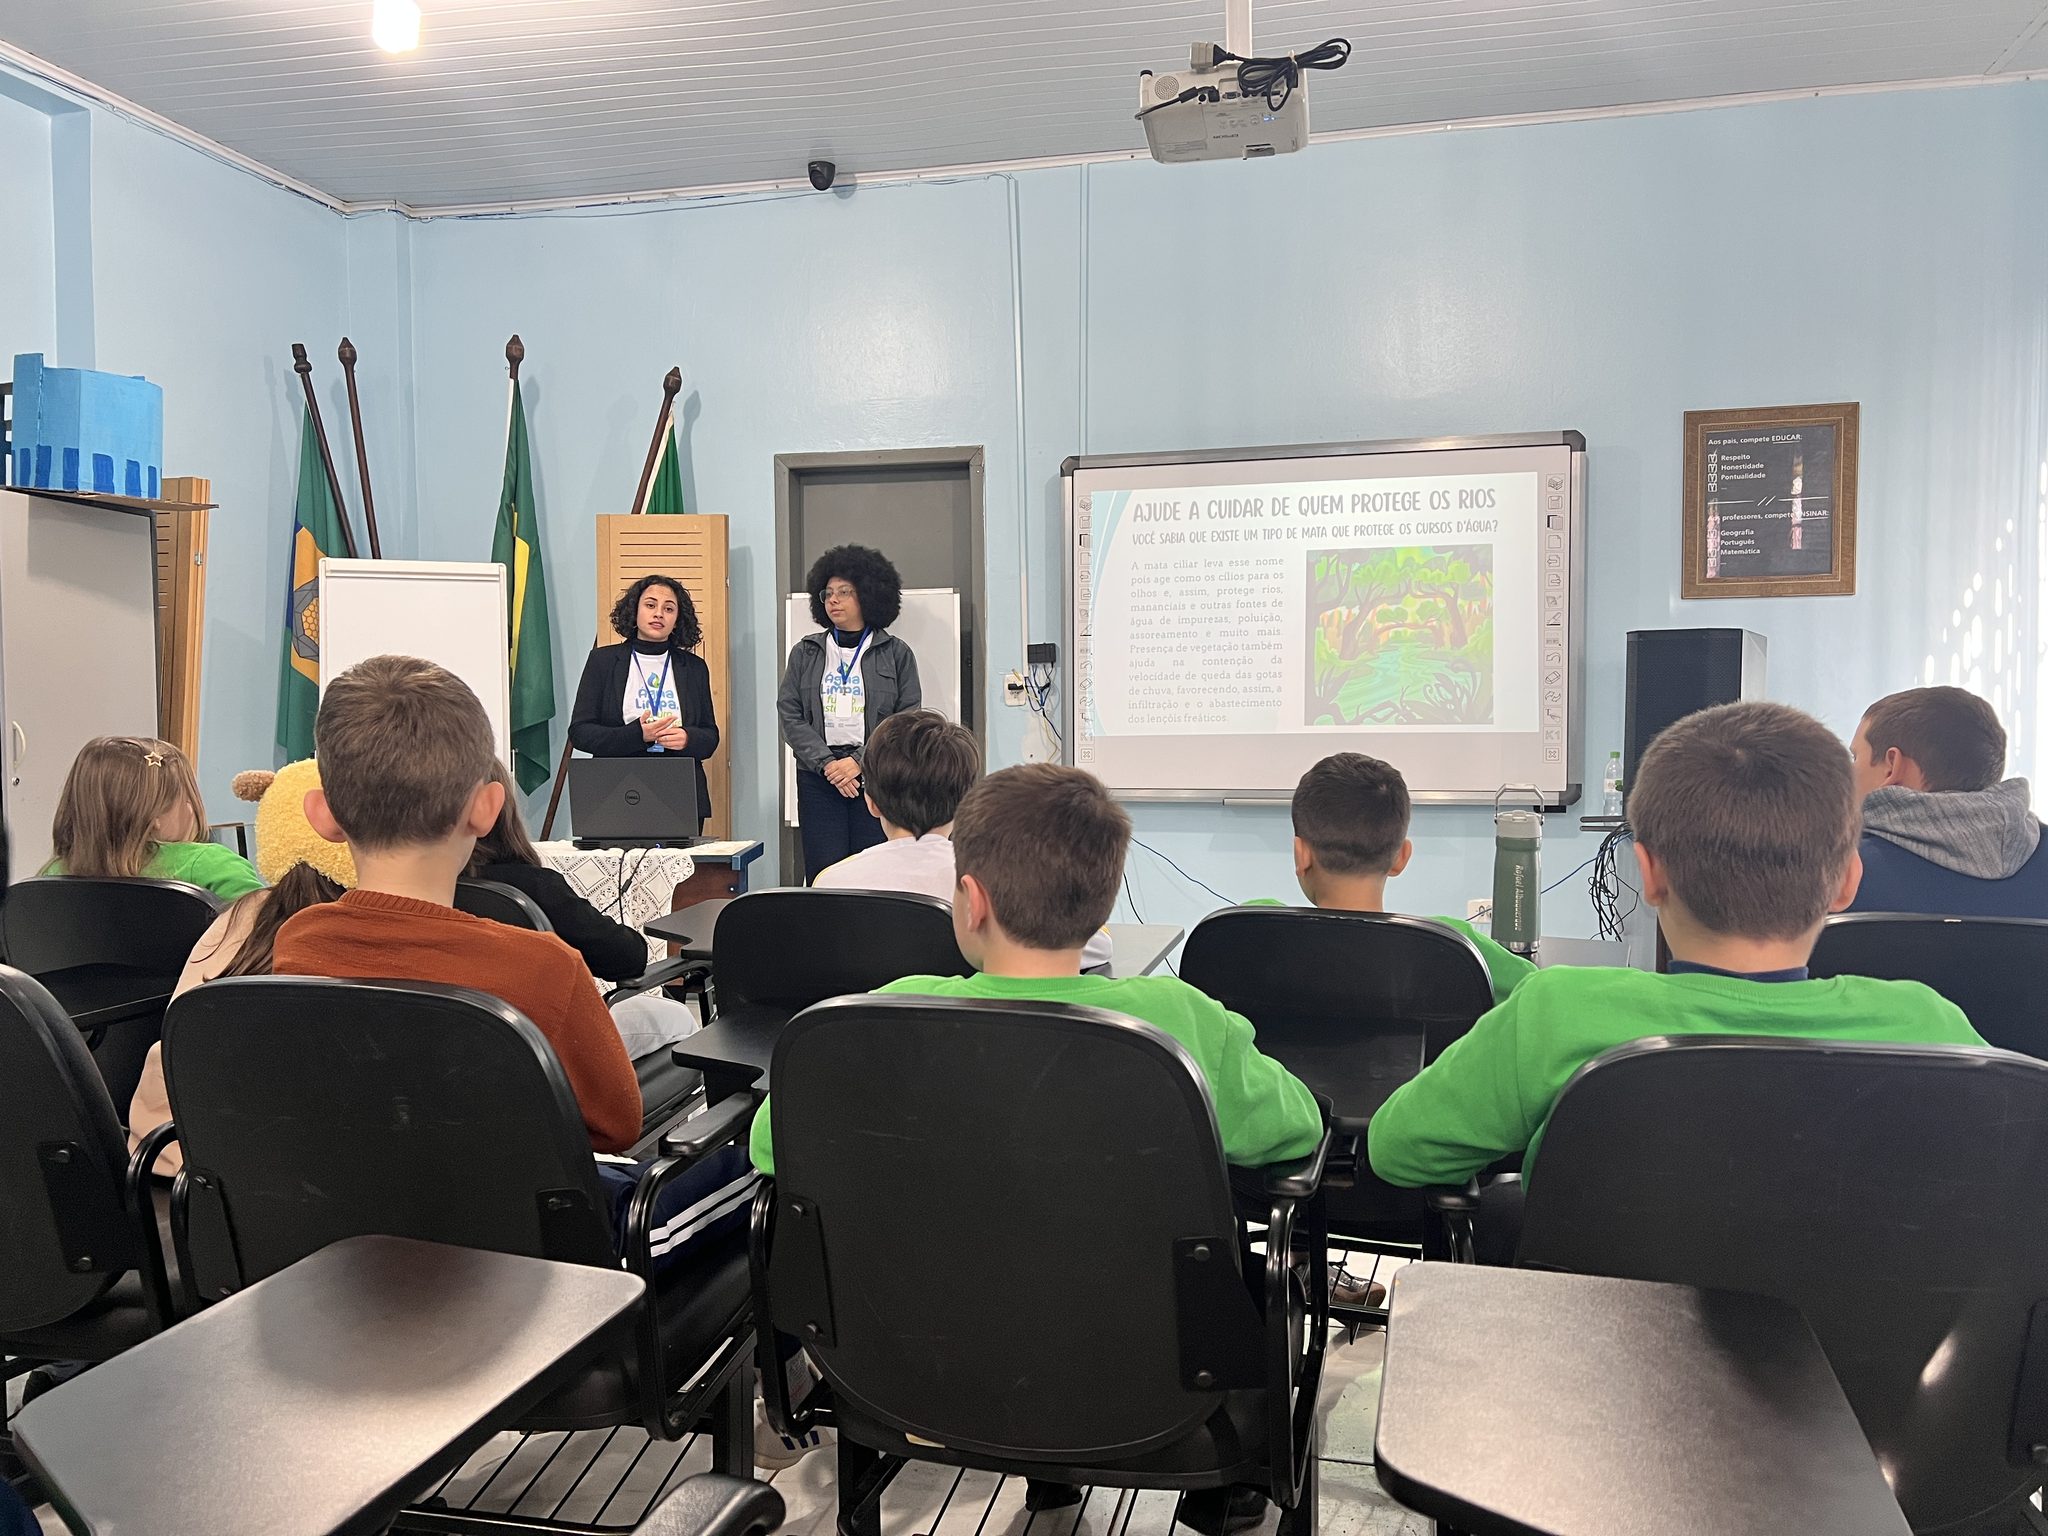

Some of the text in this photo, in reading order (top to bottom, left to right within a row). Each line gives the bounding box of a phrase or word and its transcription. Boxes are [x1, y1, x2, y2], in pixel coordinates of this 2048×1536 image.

[1740, 436, 1770, 444] compete
[1721, 454, 1751, 462] Respeito
[1721, 462, 1764, 471] Honestidade
[1721, 472, 1766, 480] Pontualidade
[1133, 488, 1496, 522] AJUDE A CUIDAR DE QUEM PROTEGE OS RIOS
[1722, 513, 1762, 522] professores,
[1797, 510, 1829, 518] NSINAR:
[1132, 518, 1498, 545] VOCÊ SABIA QUE EXISTE UM TIPO DE MATA QUE PROTEGE OS CURSOS D'ÁGUA?
[1721, 529, 1754, 537] Geografia
[1131, 558, 1284, 570] A mata ciliar leva esse nome
[1131, 575, 1151, 586] pois
[1153, 576, 1170, 585] age
[1174, 574, 1201, 583] como
[1204, 574, 1215, 582] os
[1248, 572, 1269, 582] para
[1130, 589, 1157, 598] olhos
[1179, 587, 1210, 597] assim,
[1217, 586, 1254, 597] protege
[1262, 585, 1283, 594] rios,
[1130, 602, 1186, 612] mananciais
[1200, 601, 1232, 610] outras
[1236, 599, 1267, 609] fontes
[1272, 599, 1283, 608] de
[1130, 616, 1153, 627] água
[1160, 616, 1171, 625] de
[1130, 630, 1198, 640] assoreamento
[1219, 628, 1249, 637] muito
[1130, 641, 1283, 654] Presença de vegetação também
[1129, 658, 1155, 669] ajuda
[1202, 656, 1254, 667] contenção
[1271, 655, 1283, 664] da
[1129, 670, 1283, 682] velocidade de queda das gotas
[1128, 686, 1140, 695] de
[1177, 684, 1240, 694] favorecendo,
[1242, 684, 1274, 693] assim,
[1128, 699, 1179, 710] infiltração
[1209, 698, 1282, 708] abastecimento
[1128, 714, 1145, 724] dos
[1147, 713, 1182, 724] lençóis
